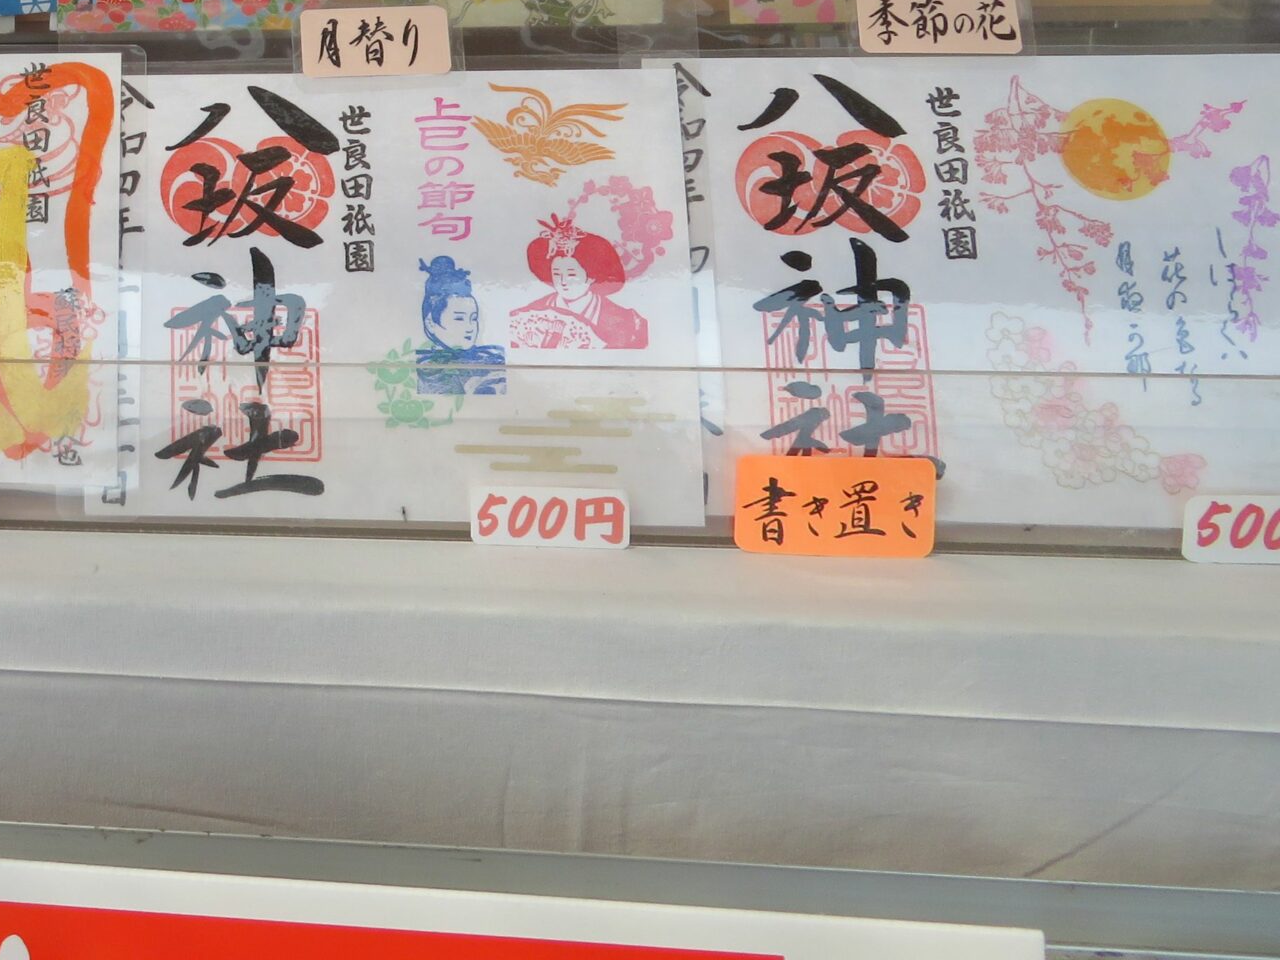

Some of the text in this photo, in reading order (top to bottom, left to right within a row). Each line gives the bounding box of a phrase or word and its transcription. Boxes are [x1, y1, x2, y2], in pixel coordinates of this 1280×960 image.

[317, 17, 421, 69] 月替り
[19, 61, 54, 226] 世良田祇園
[338, 104, 378, 275] 世良田祇園
[925, 85, 978, 260] 世良田祇園
[154, 84, 342, 502] 八坂神社
[476, 493, 626, 545] 500円
[741, 476, 925, 547] 書き置き
